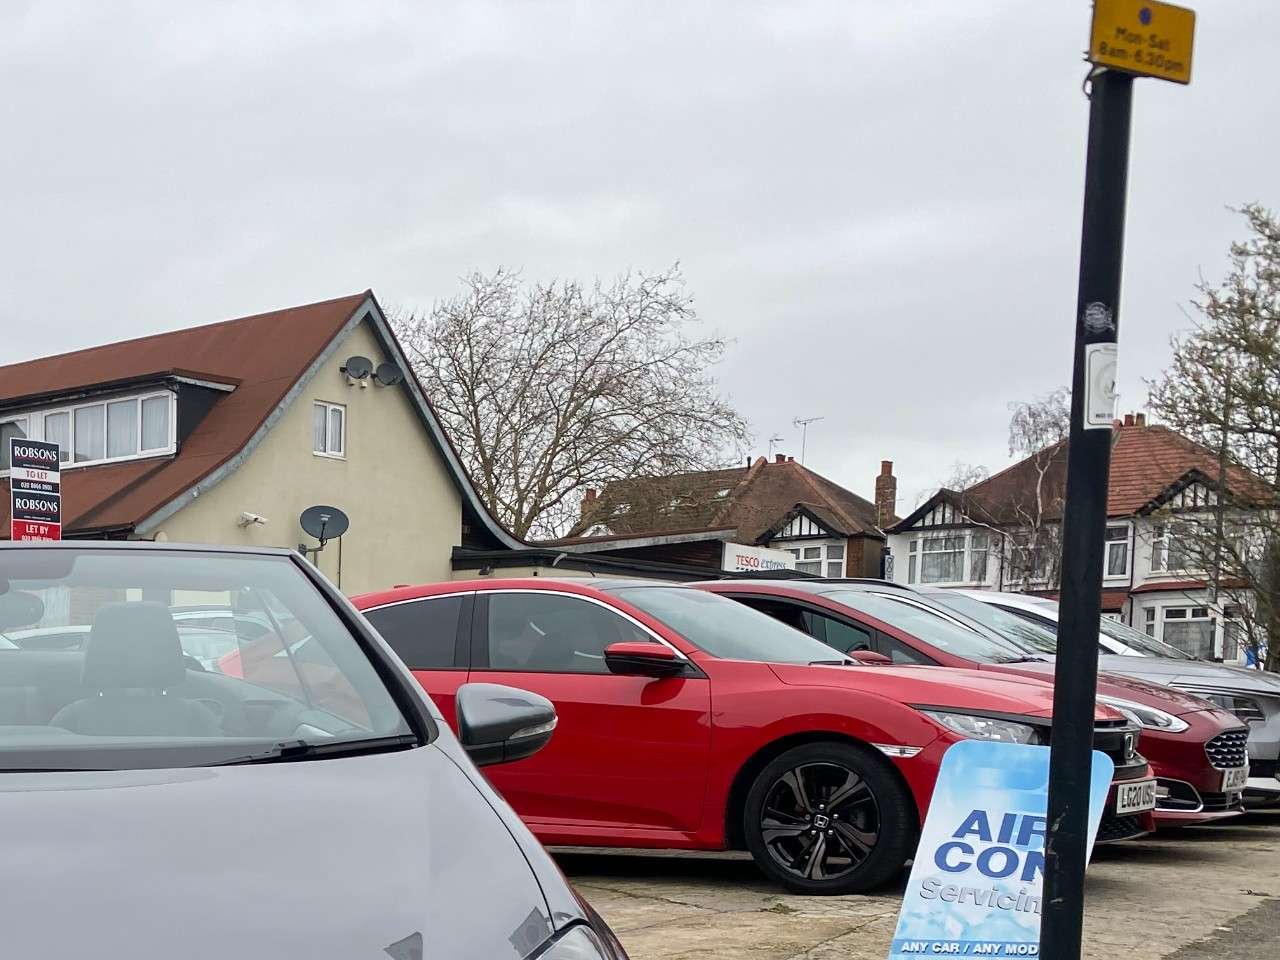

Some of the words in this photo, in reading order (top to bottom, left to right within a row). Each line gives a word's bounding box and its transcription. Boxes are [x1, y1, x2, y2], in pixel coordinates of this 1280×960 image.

[14, 446, 57, 461] ROBSONS
[26, 470, 36, 478] TO
[37, 471, 48, 480] LET
[15, 498, 58, 513] ROBSONS
[26, 524, 38, 533] LET
[40, 525, 49, 534] BY
[736, 554, 760, 567] TESCO
[919, 876, 1044, 915] Servicin
[901, 941, 927, 953] ANY
[932, 942, 960, 954] CAR
[973, 943, 1001, 955] ANY
